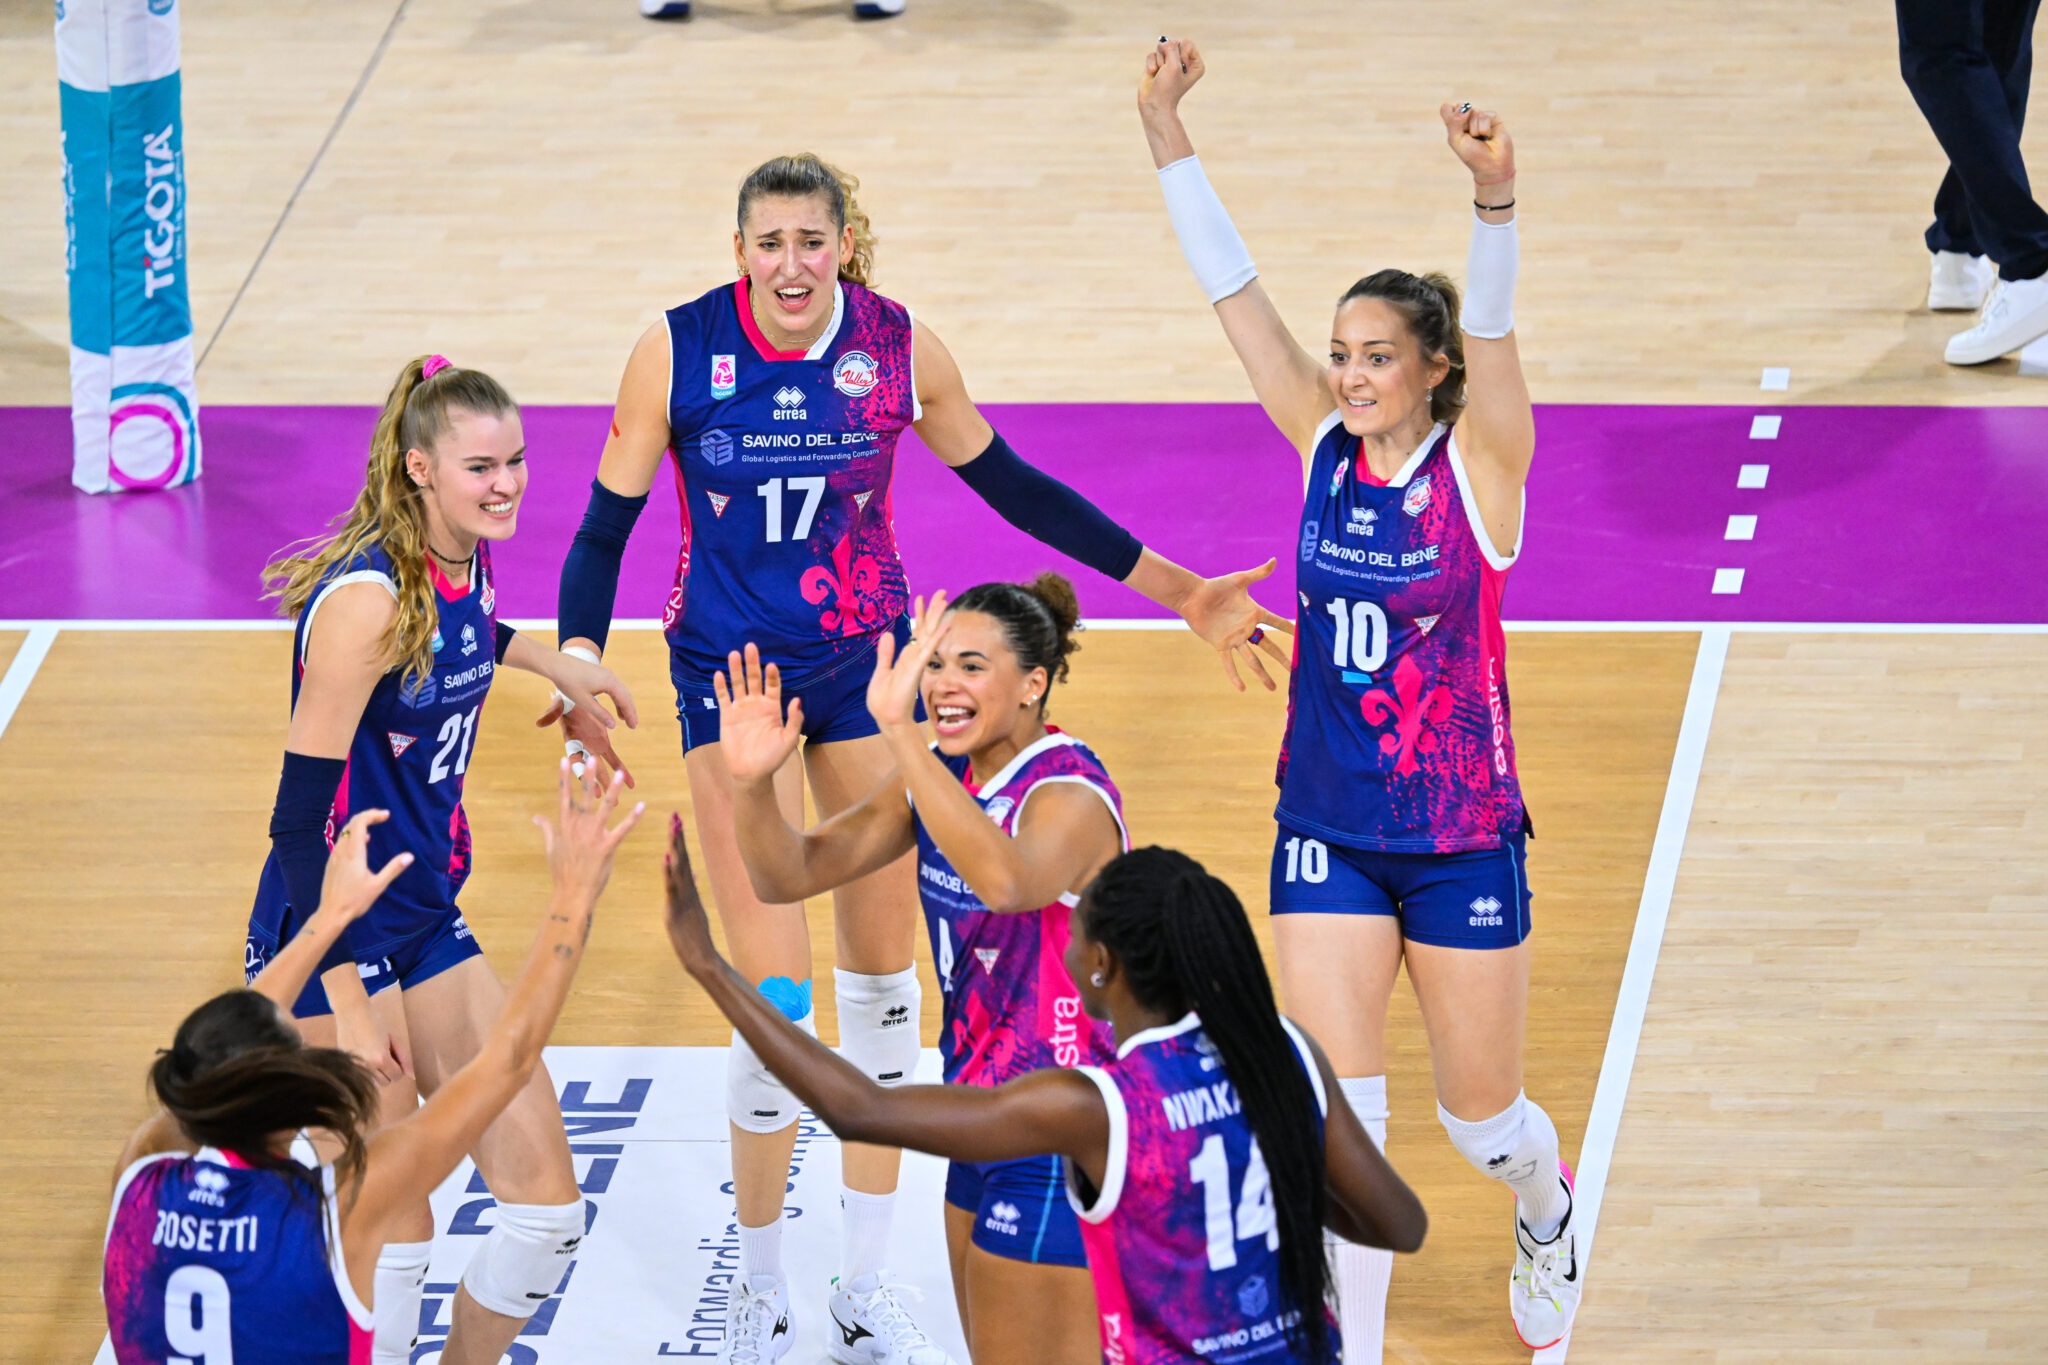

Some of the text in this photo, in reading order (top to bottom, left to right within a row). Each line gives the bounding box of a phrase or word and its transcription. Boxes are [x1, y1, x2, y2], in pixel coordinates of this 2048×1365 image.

[742, 432, 879, 448] SAVINO DEL BENE
[742, 454, 764, 463] Global
[766, 454, 796, 464] Logistics
[798, 453, 811, 462] and
[812, 452, 851, 463] Forwarding
[757, 476, 826, 542] 17
[1320, 539, 1440, 567] SAVINO DEL BENE
[1332, 565, 1359, 578] Logistics
[1360, 572, 1372, 580] and
[1373, 574, 1410, 584] Forwarding
[1411, 568, 1441, 581] Company
[1326, 597, 1388, 672] 10
[444, 667, 477, 689] SAVINO
[478, 661, 492, 678] DEL
[391, 734, 412, 744] GUESS
[428, 705, 478, 784] 21
[1285, 837, 1329, 883] 10
[939, 917, 954, 992] 4
[1190, 1135, 1280, 1271] 14
[164, 1264, 233, 1365] 9
